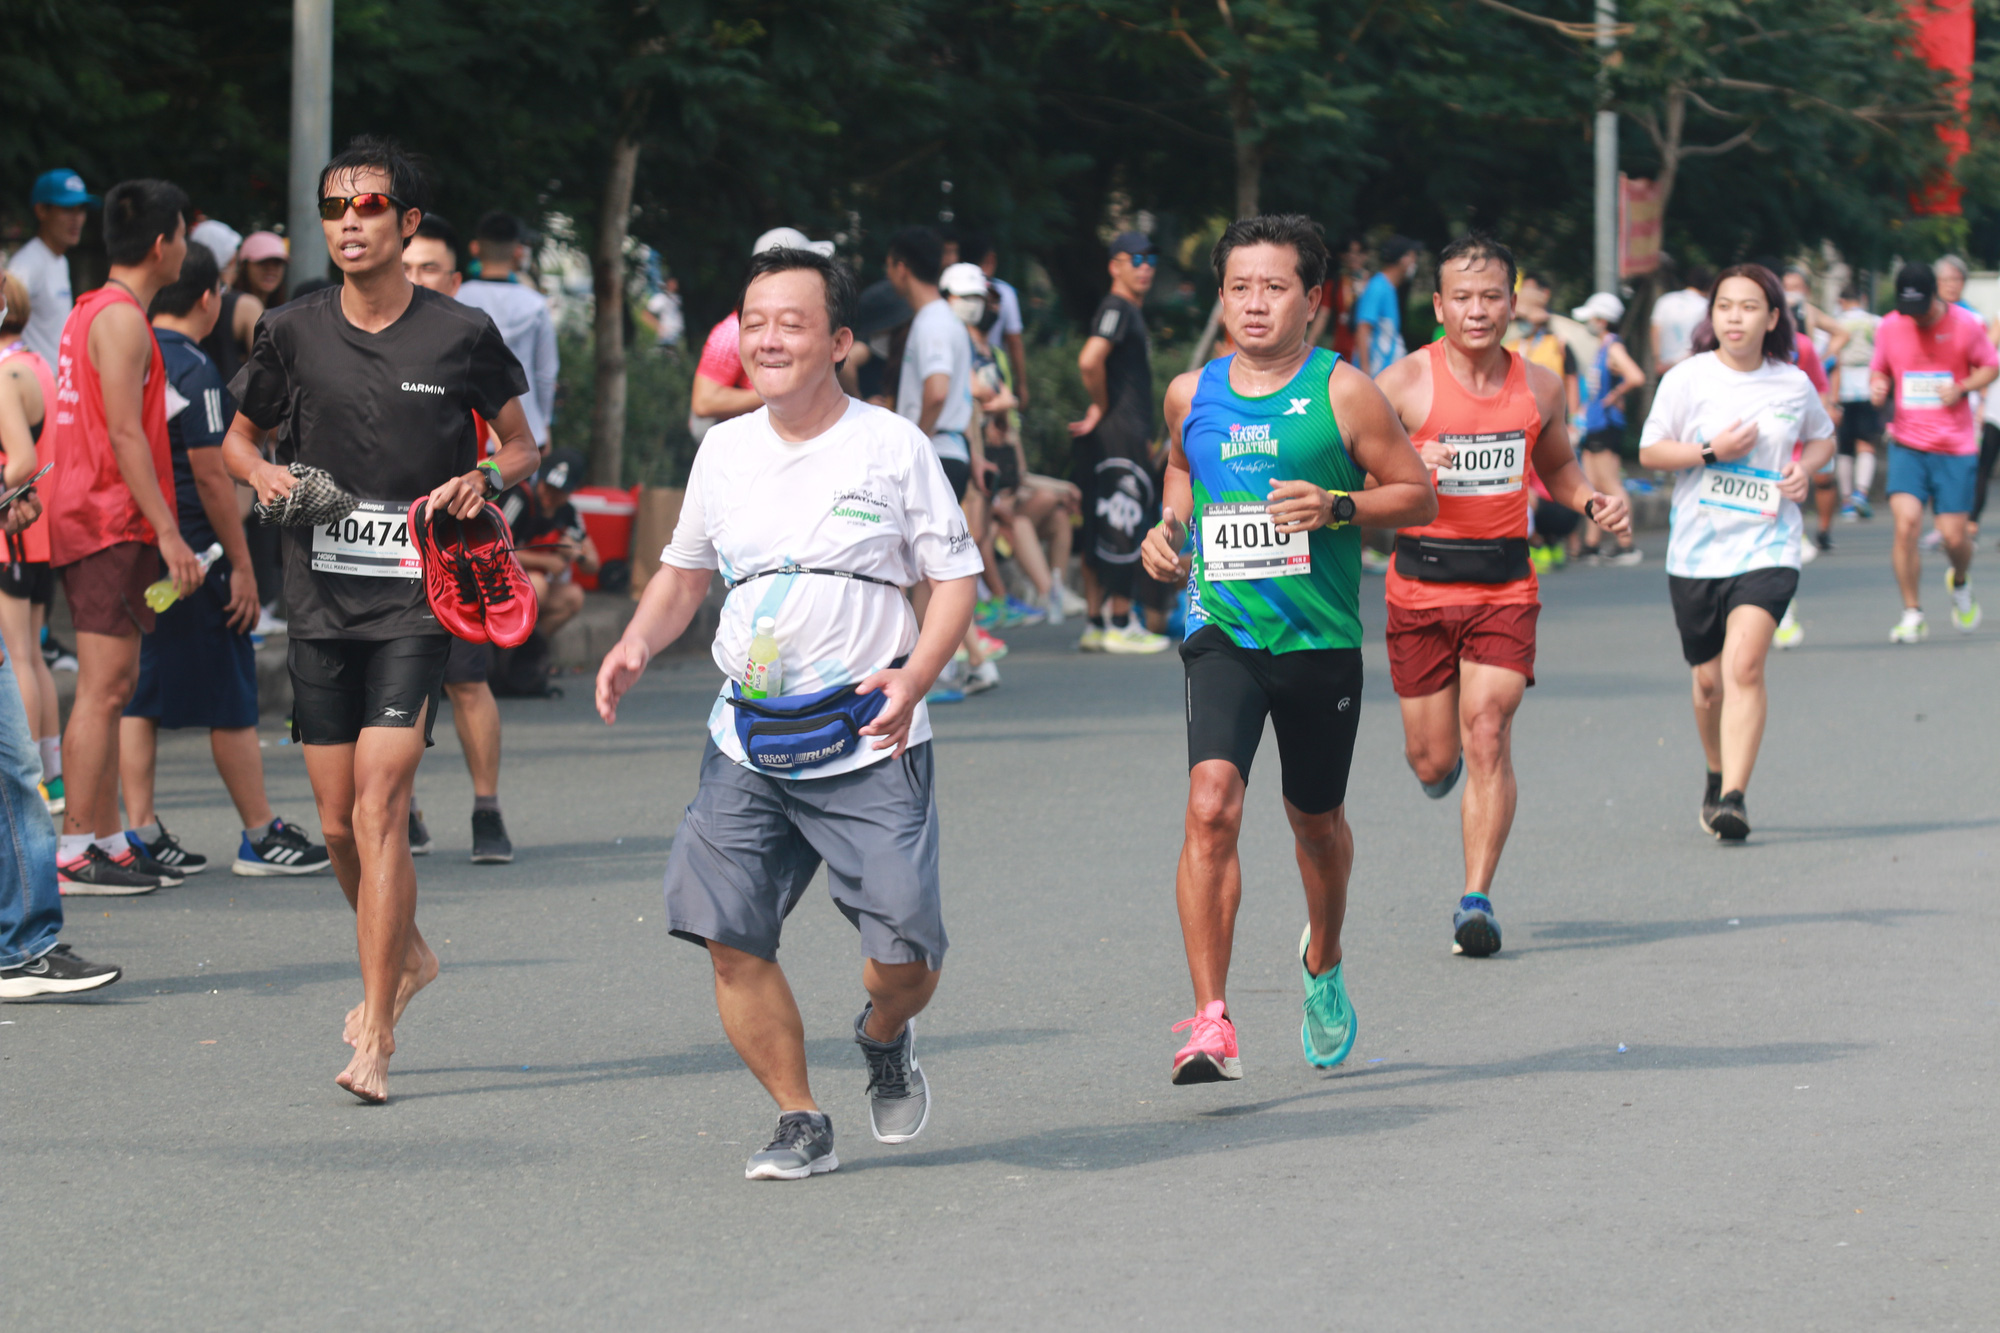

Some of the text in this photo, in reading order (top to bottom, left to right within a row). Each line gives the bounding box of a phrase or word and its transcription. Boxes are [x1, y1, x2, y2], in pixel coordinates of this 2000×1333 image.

[401, 382, 446, 395] GARMIN
[1229, 430, 1270, 442] HANOI
[1221, 439, 1278, 460] MARATHON
[1452, 447, 1514, 470] 40078
[1711, 475, 1769, 501] 20705
[358, 501, 385, 512] Salonpas
[1239, 504, 1265, 513] Salonpas
[831, 505, 882, 523] Salonpas
[325, 518, 409, 548] 40474
[317, 553, 337, 561] HOKA
[334, 564, 358, 572] MARATHON
[1208, 561, 1225, 570] HOKA
